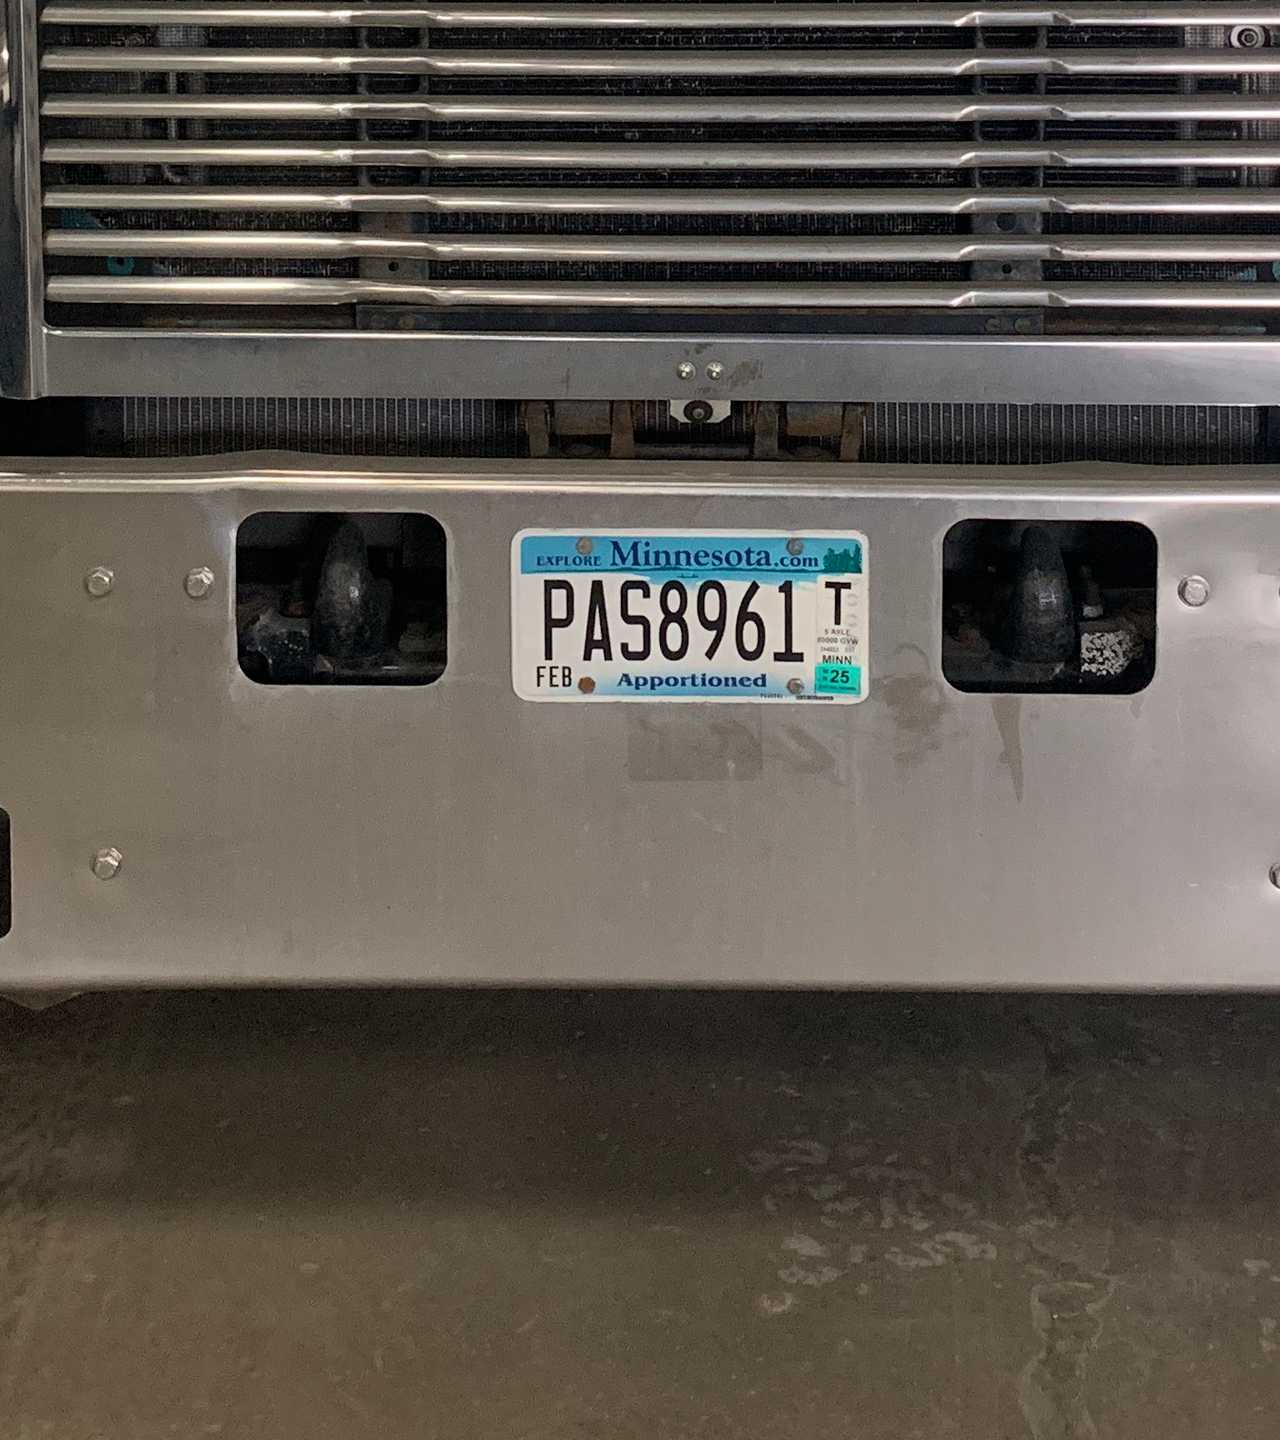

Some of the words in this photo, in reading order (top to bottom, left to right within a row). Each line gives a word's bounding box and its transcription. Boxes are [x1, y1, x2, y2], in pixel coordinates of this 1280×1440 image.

[536, 555, 602, 567] EXPLORE
[610, 540, 819, 568] Minnesota.com
[544, 579, 805, 662] PAS8961
[824, 581, 852, 626] T
[822, 655, 852, 665] MINN
[536, 666, 572, 688] FEB
[617, 672, 767, 691] Apportioned
[830, 669, 850, 684] 25
